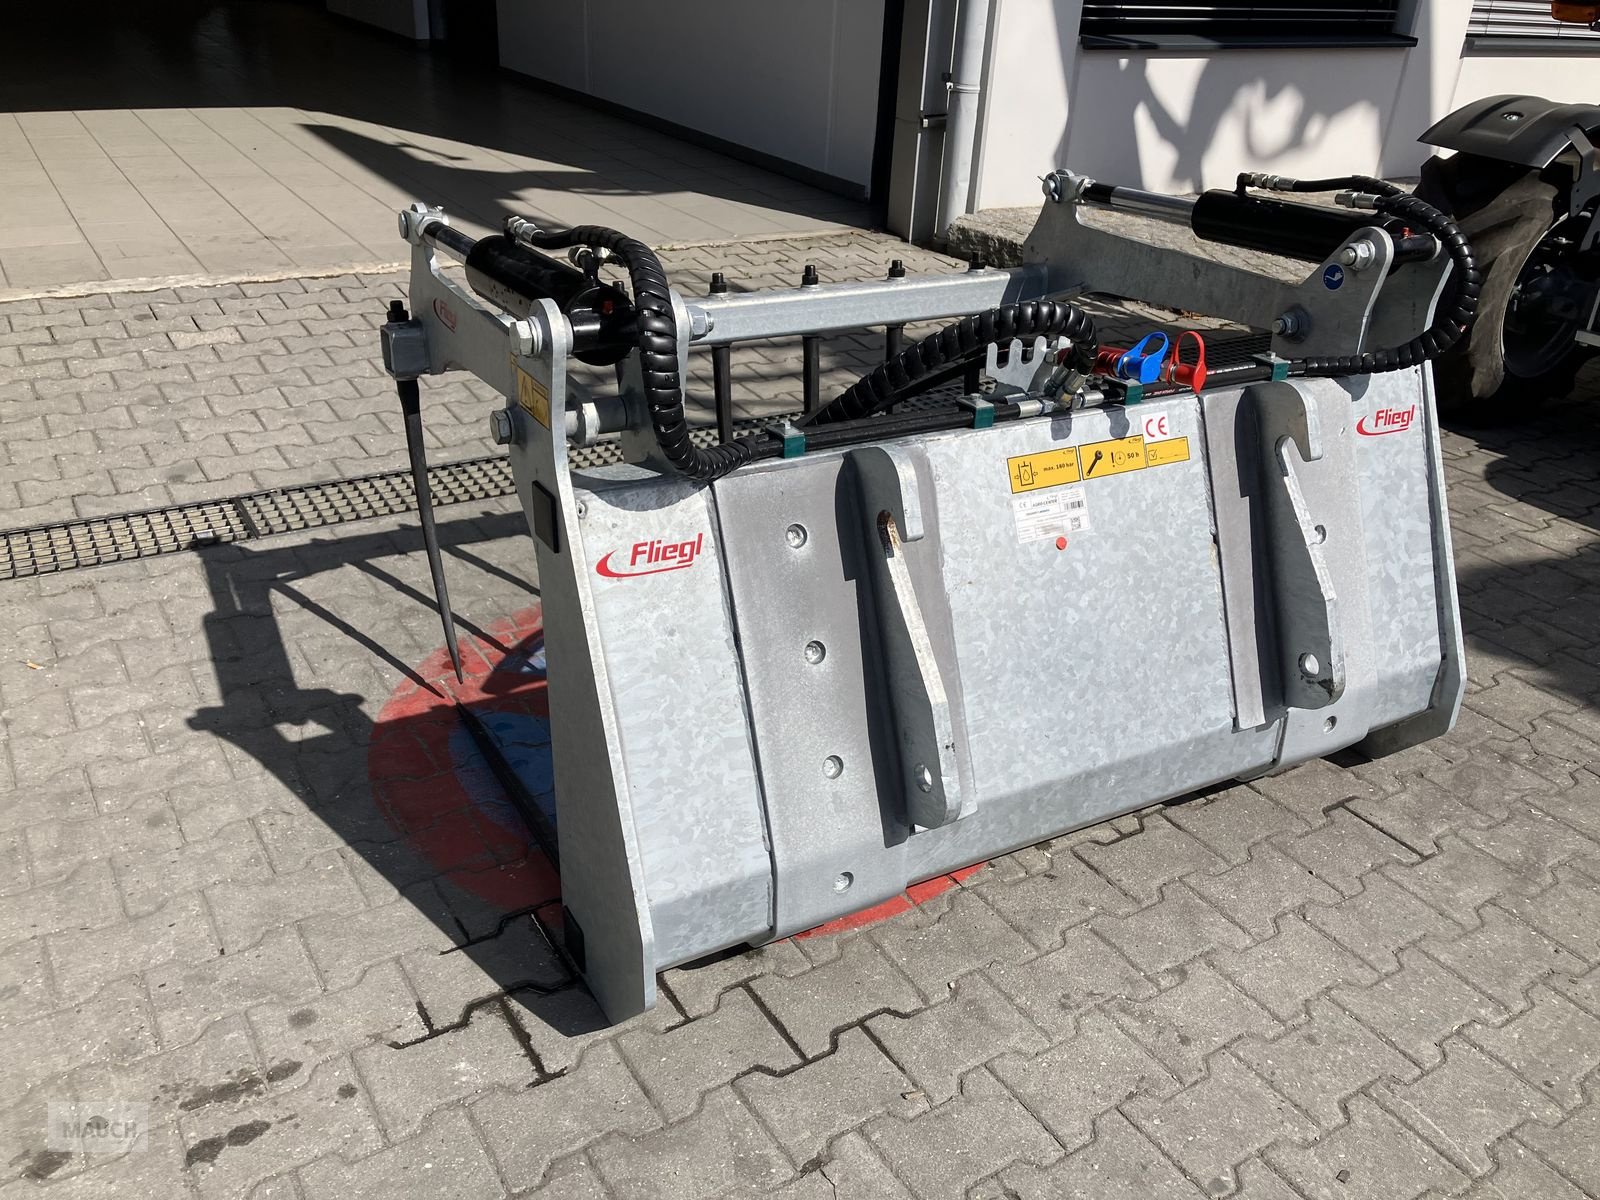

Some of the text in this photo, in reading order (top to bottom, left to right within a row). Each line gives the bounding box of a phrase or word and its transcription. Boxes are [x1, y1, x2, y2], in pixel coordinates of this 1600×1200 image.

[1145, 416, 1168, 438] CE
[1374, 404, 1415, 428] Fliegl
[1127, 452, 1135, 460] 50
[630, 532, 703, 566] Fliegl
